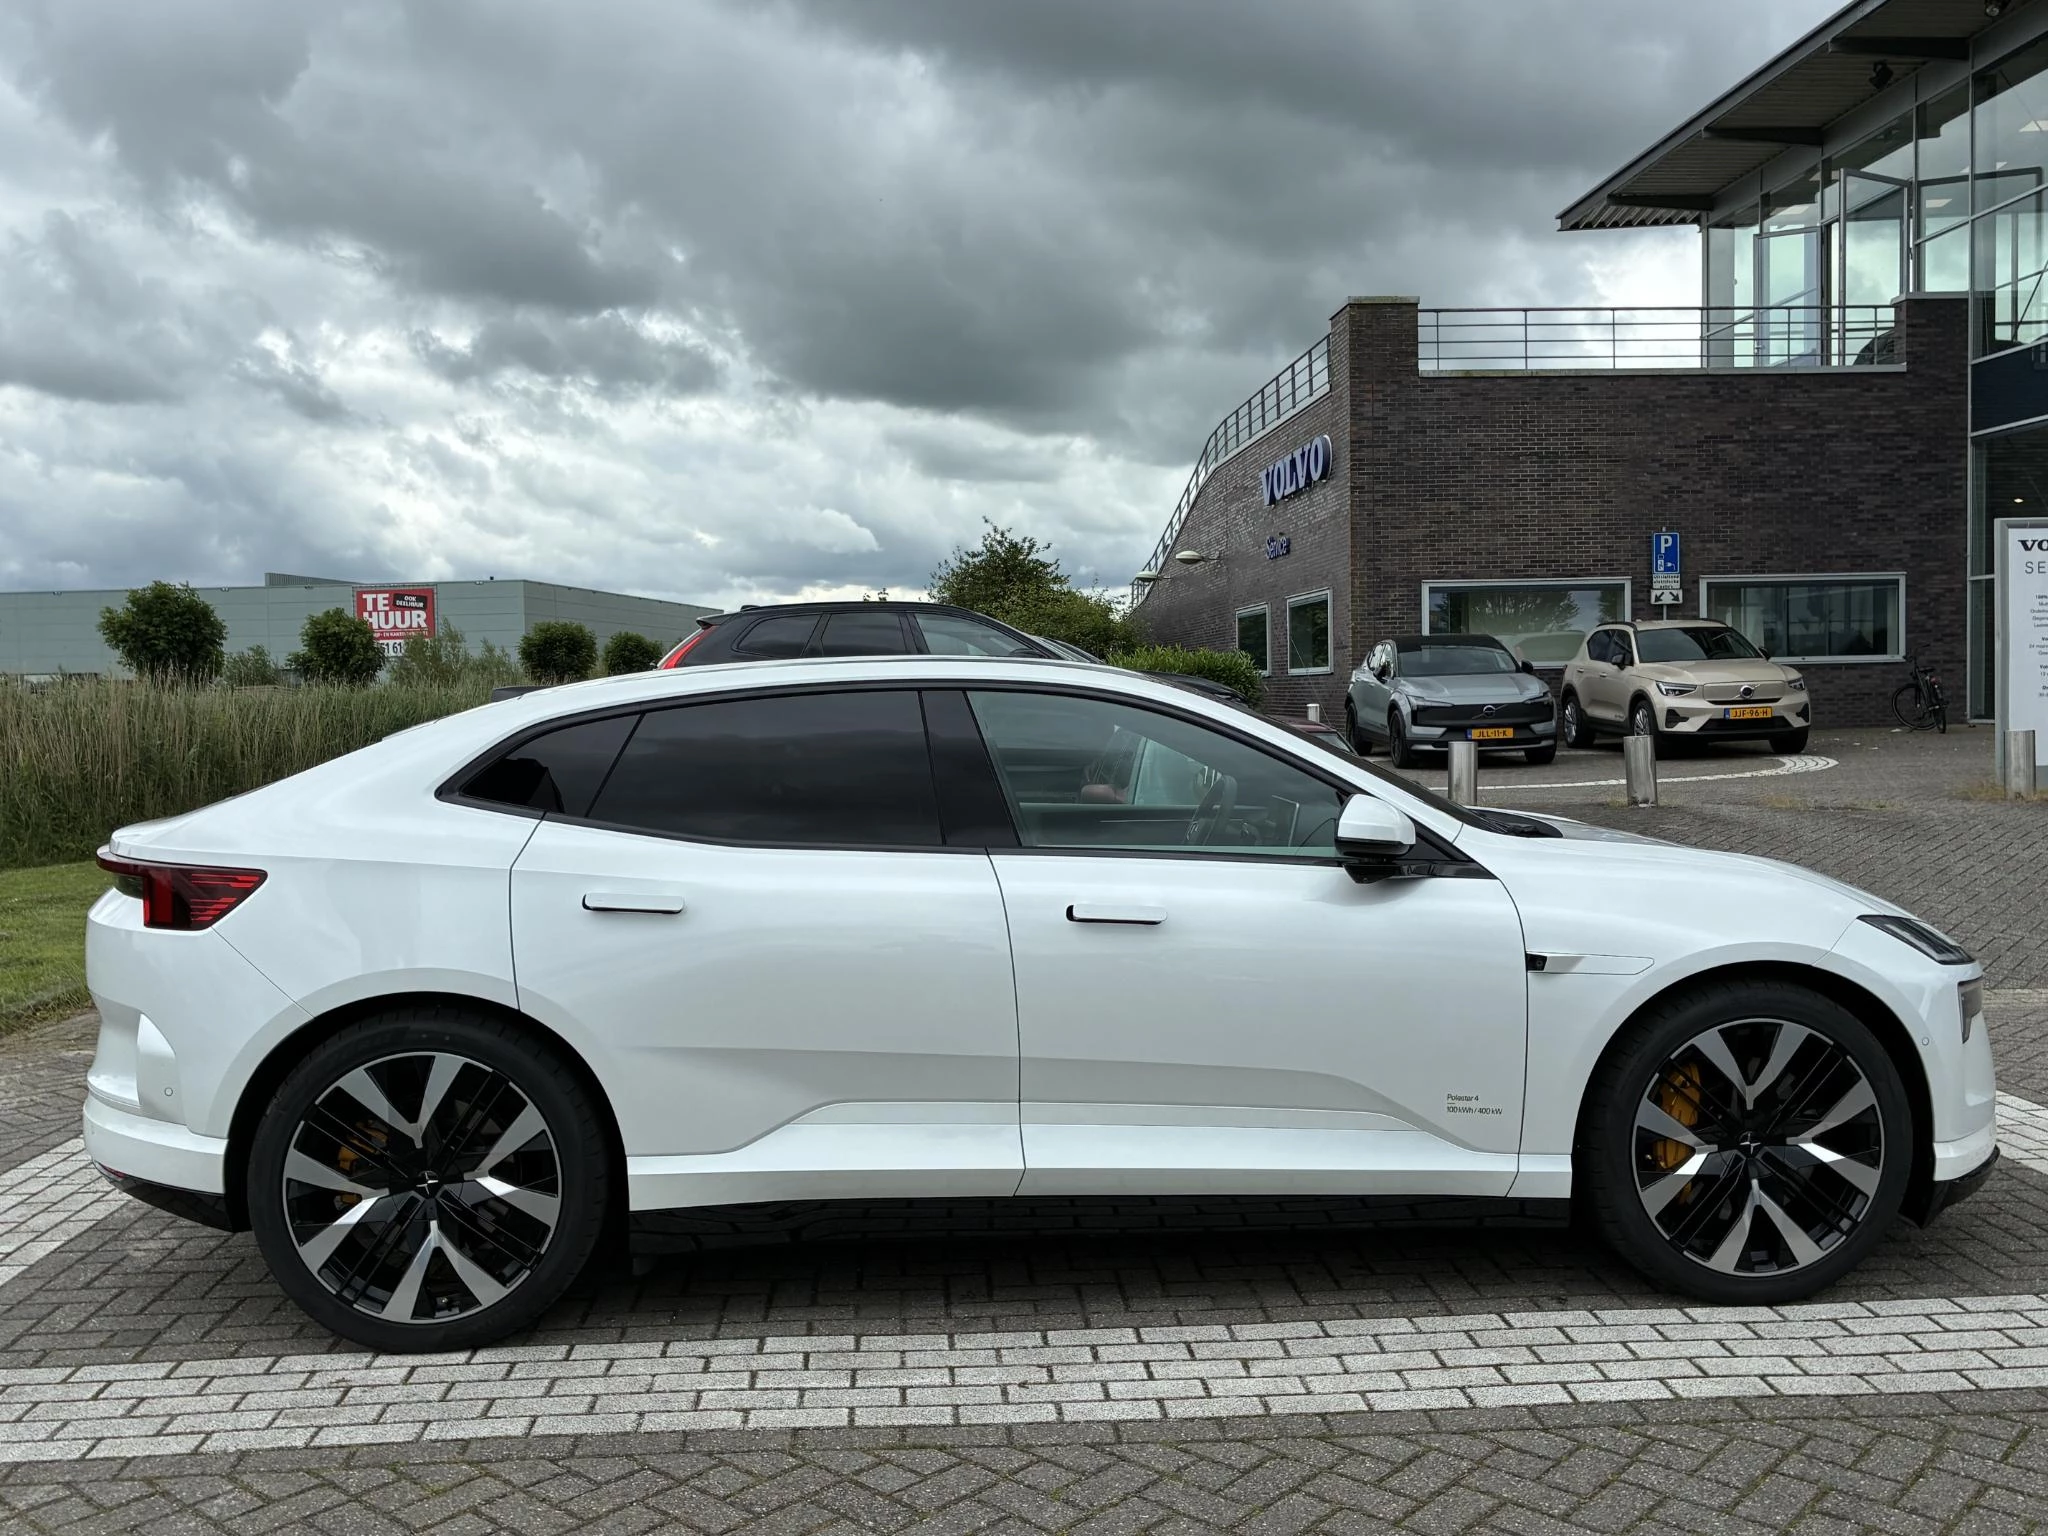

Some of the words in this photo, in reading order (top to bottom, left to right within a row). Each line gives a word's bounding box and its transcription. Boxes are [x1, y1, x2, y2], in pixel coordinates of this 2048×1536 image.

[1259, 435, 1332, 507] VOLVO
[1661, 535, 1673, 553] P
[2024, 561, 2047, 574] SE
[362, 593, 390, 611] TE
[362, 611, 427, 629] HUUR
